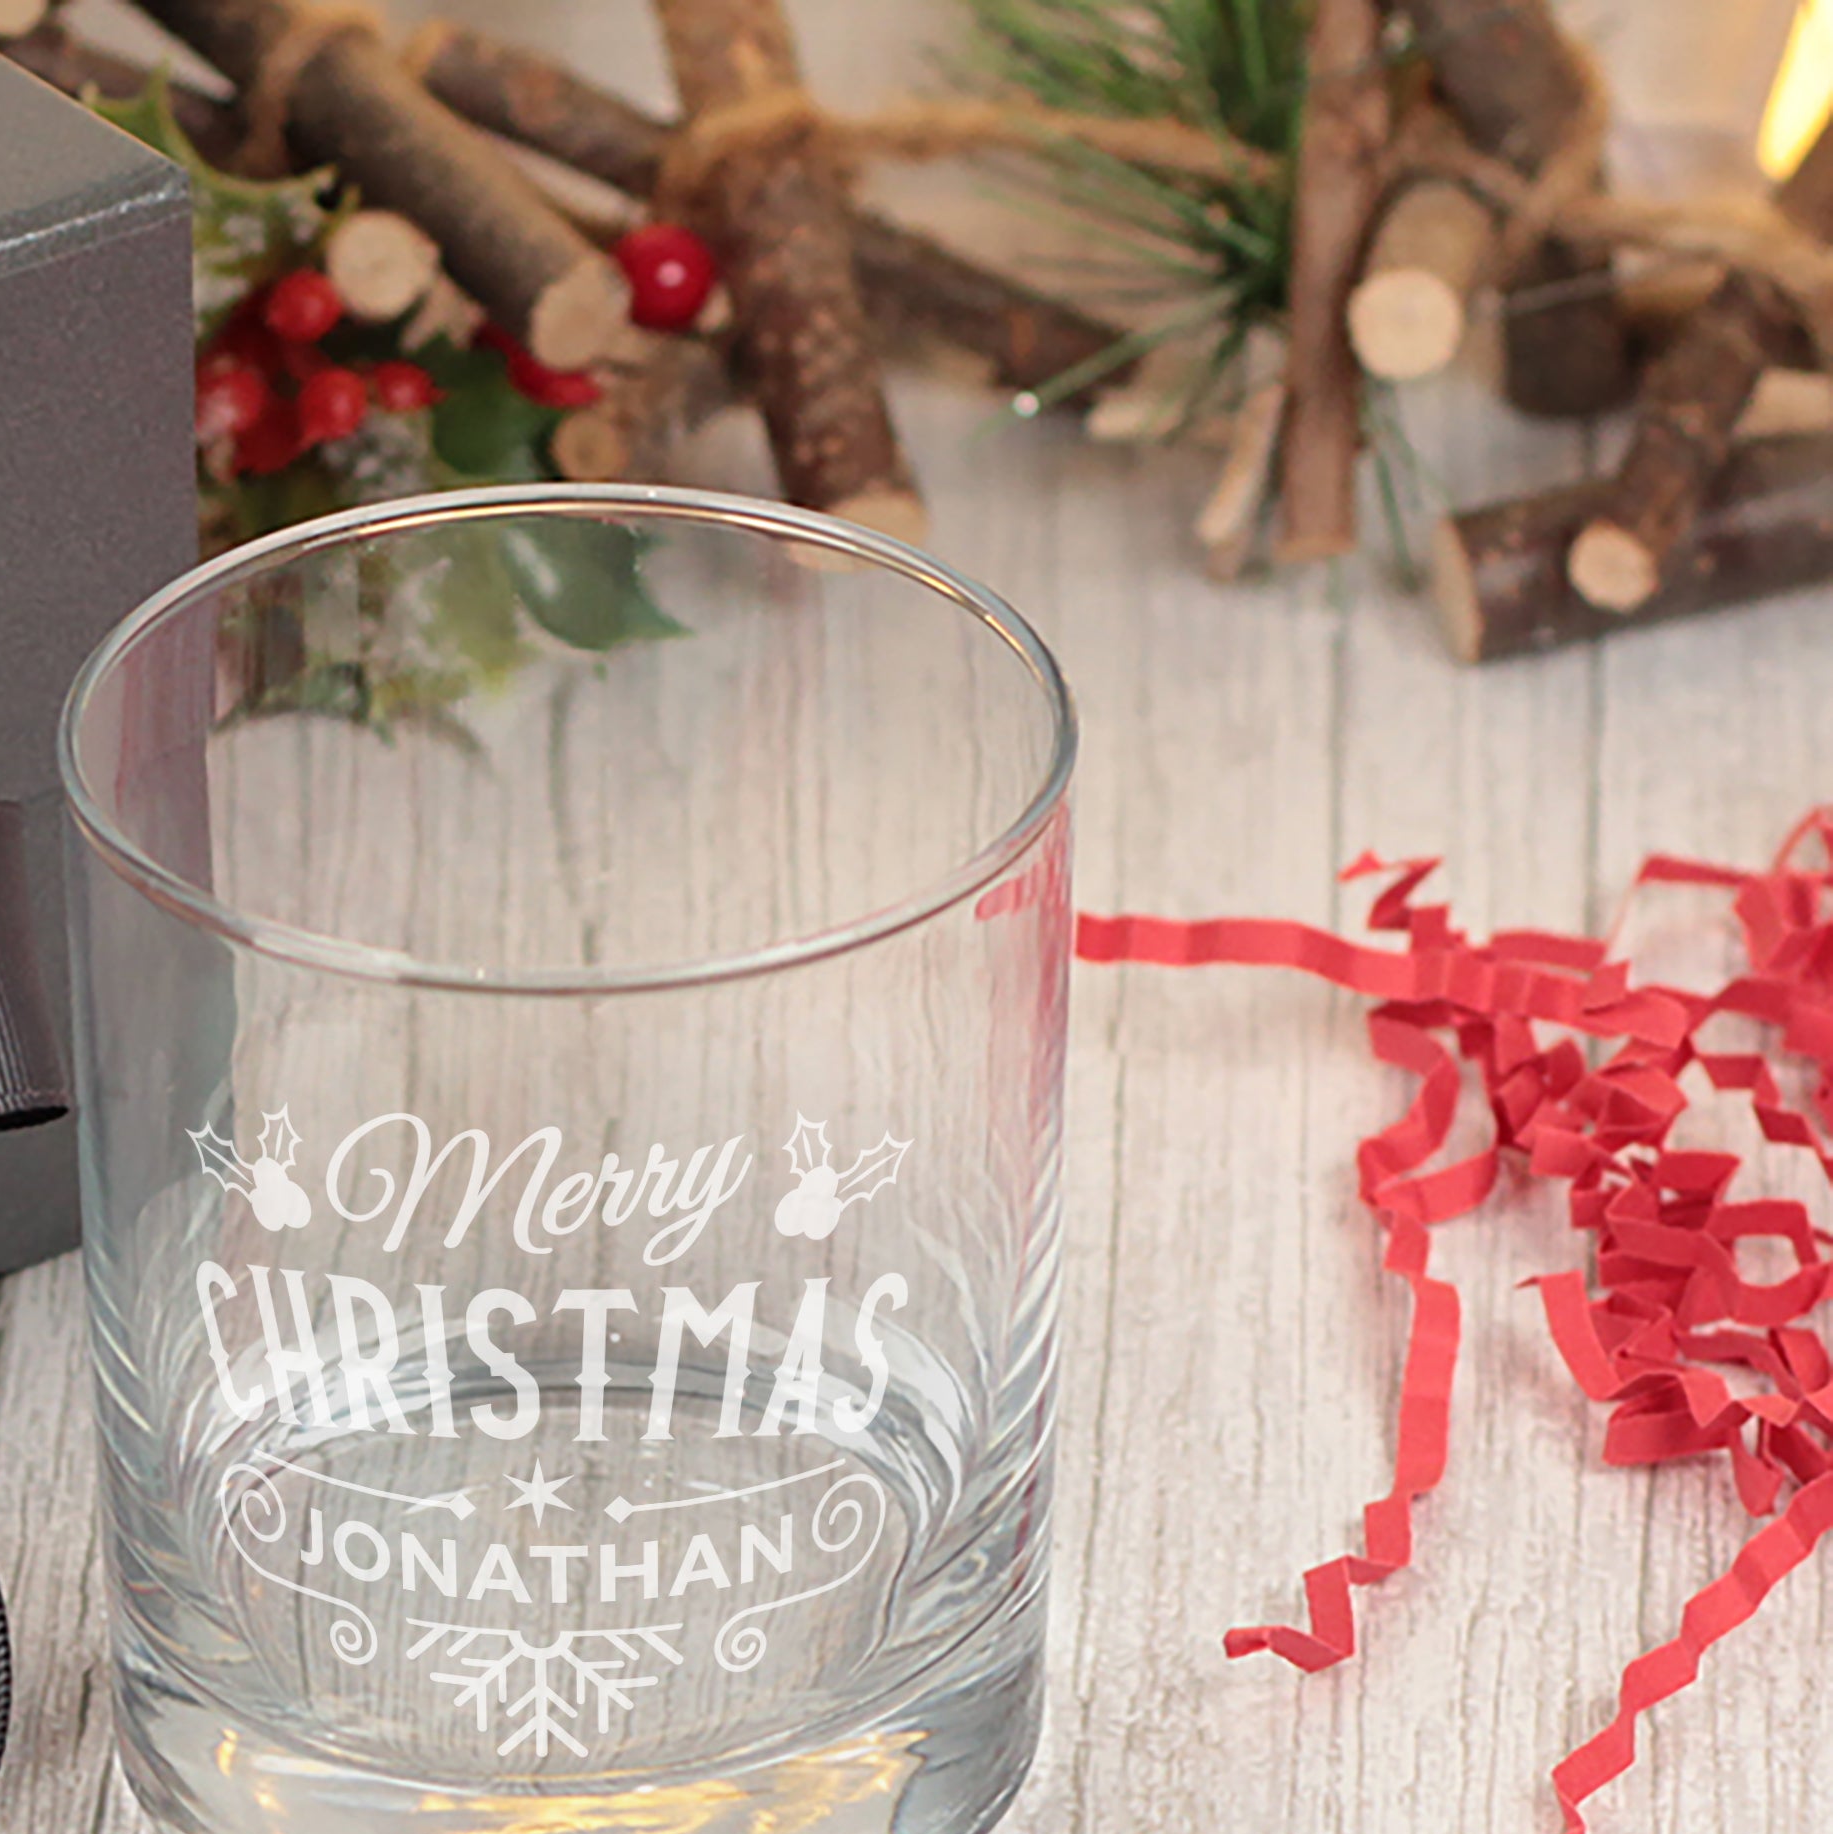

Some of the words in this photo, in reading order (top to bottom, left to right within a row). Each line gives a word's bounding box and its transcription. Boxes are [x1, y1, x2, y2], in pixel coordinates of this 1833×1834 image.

[325, 1111, 754, 1266] Merry
[195, 1259, 910, 1442] CHRISTMAS
[299, 1506, 794, 1604] JONATHAN
